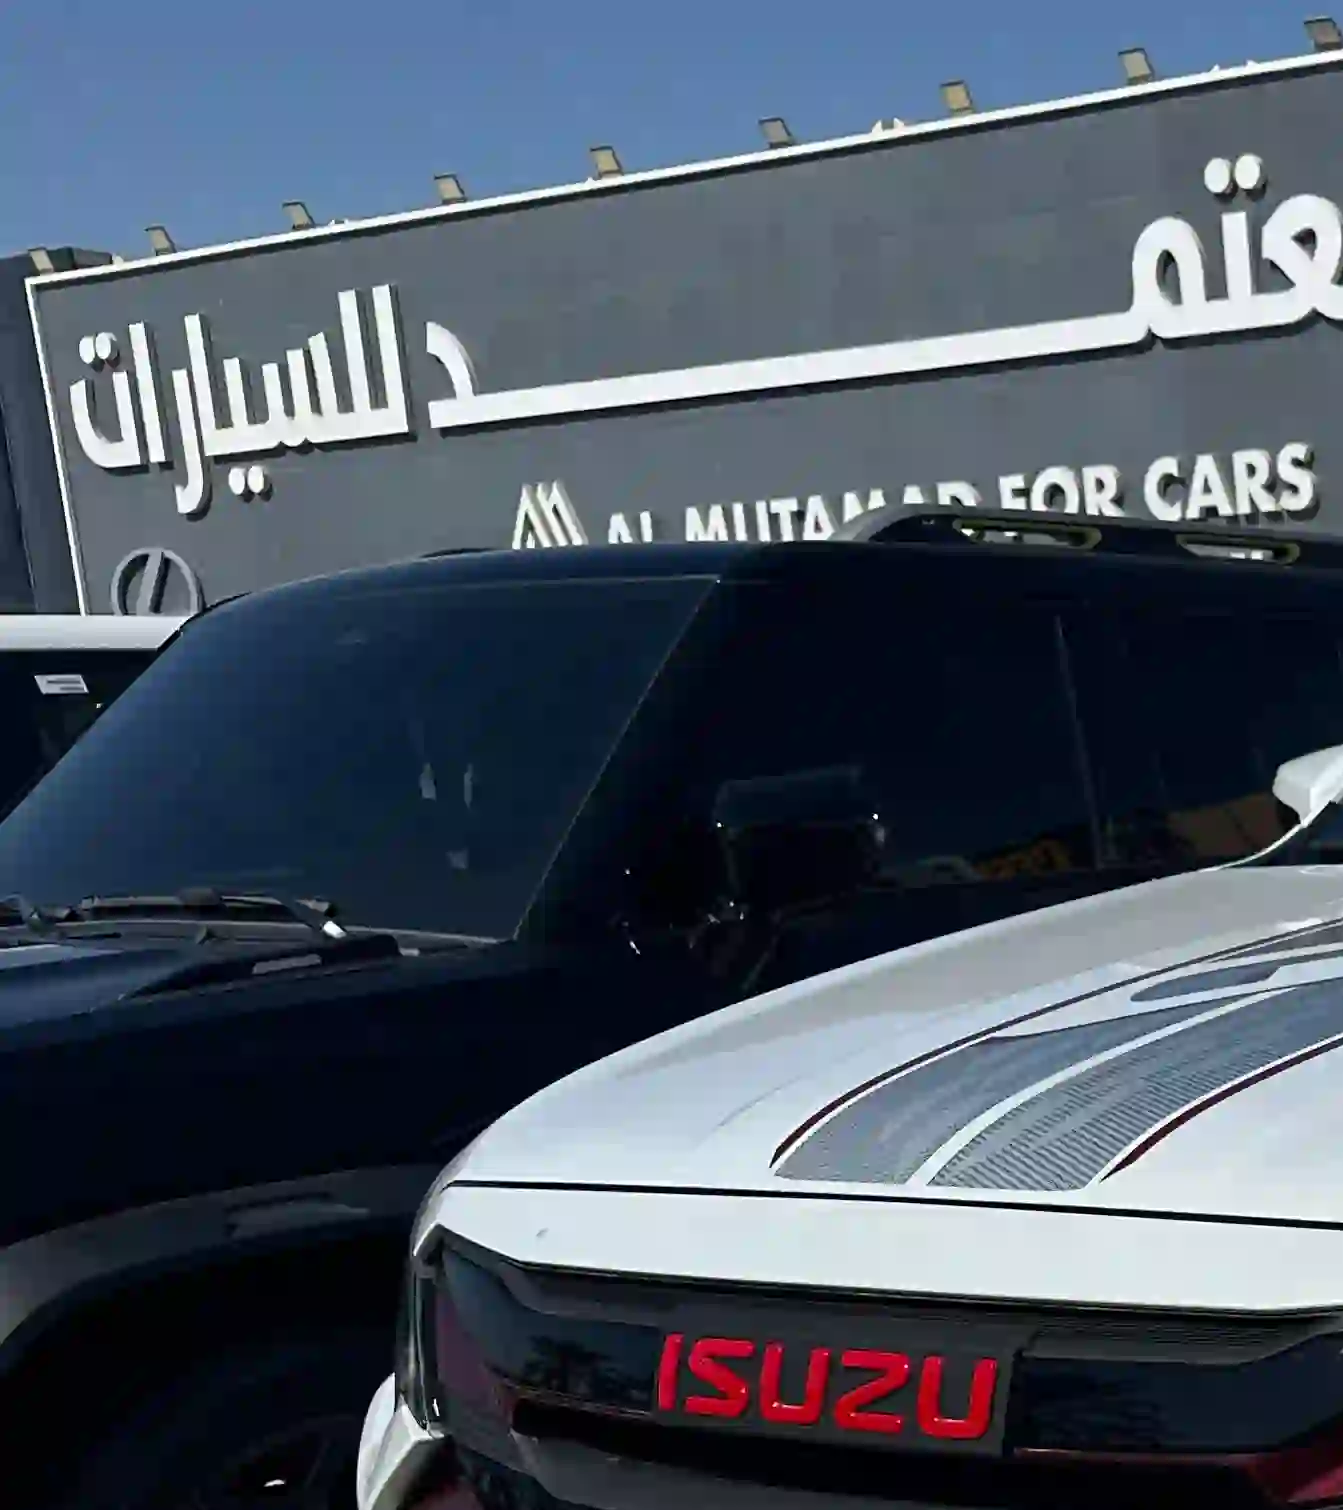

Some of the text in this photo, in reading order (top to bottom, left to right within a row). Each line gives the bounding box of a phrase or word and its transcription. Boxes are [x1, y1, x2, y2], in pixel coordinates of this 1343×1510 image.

[69, 283, 409, 514] للسيارات
[999, 464, 1126, 517] FOR
[1143, 443, 1314, 522] CARS
[657, 1333, 998, 1439] ISUZU
